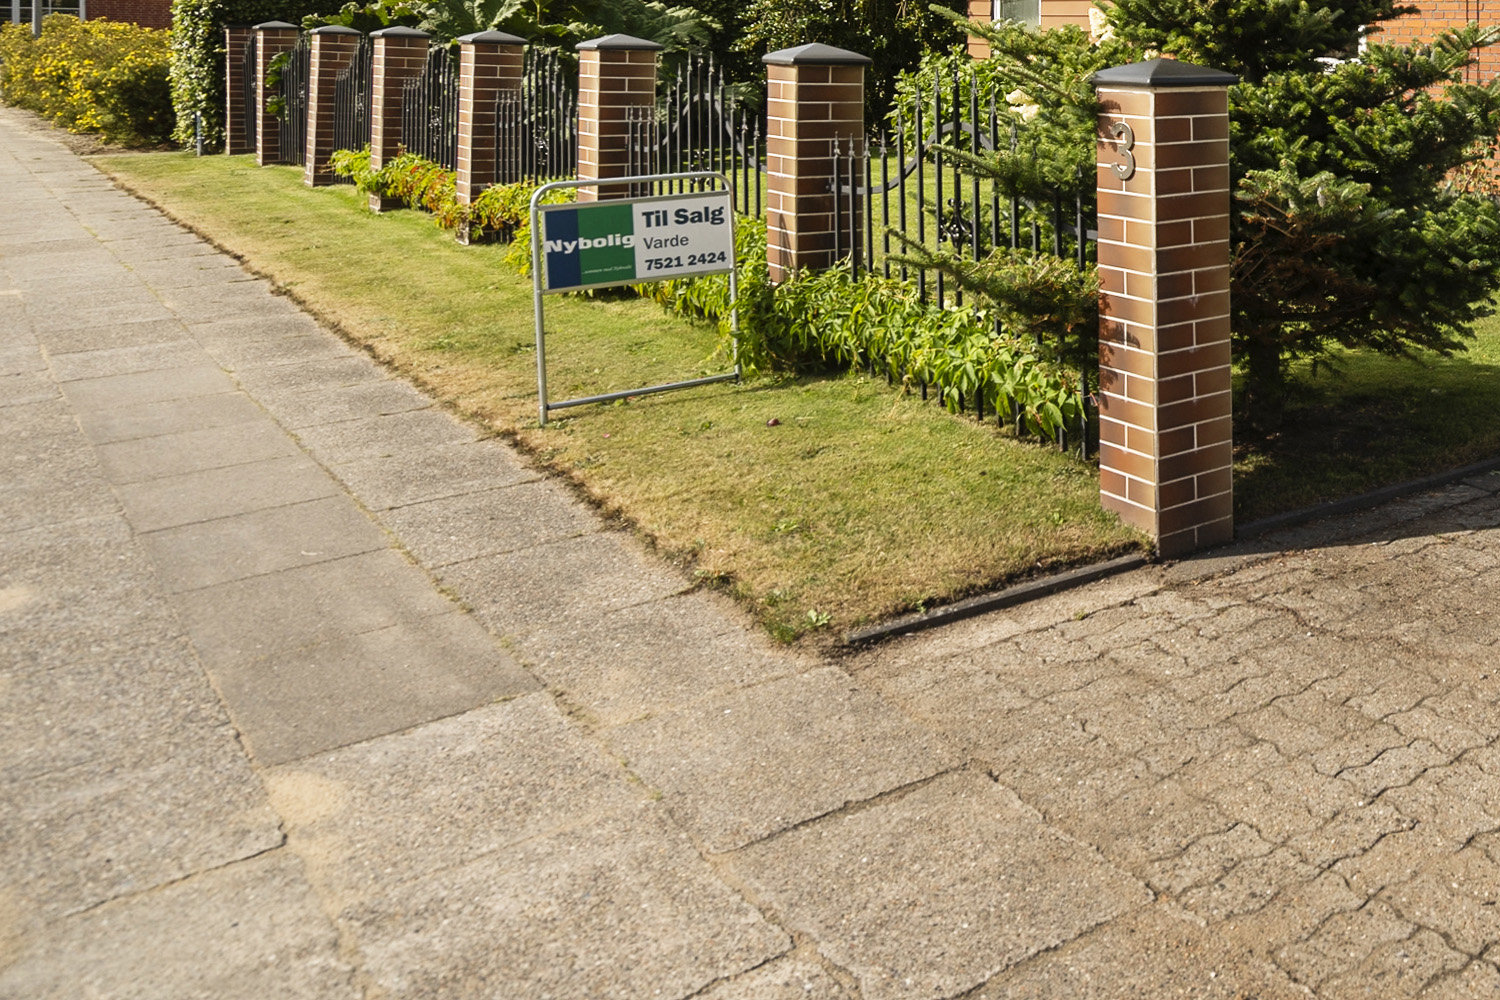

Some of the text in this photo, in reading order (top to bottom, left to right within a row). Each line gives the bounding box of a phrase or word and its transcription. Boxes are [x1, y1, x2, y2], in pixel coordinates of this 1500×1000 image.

[1110, 121, 1135, 181] 3
[642, 206, 725, 228] Til Salg
[545, 233, 635, 254] Nybolig
[643, 234, 690, 250] Varde
[645, 255, 683, 271] 7521
[687, 251, 727, 266] 2424
